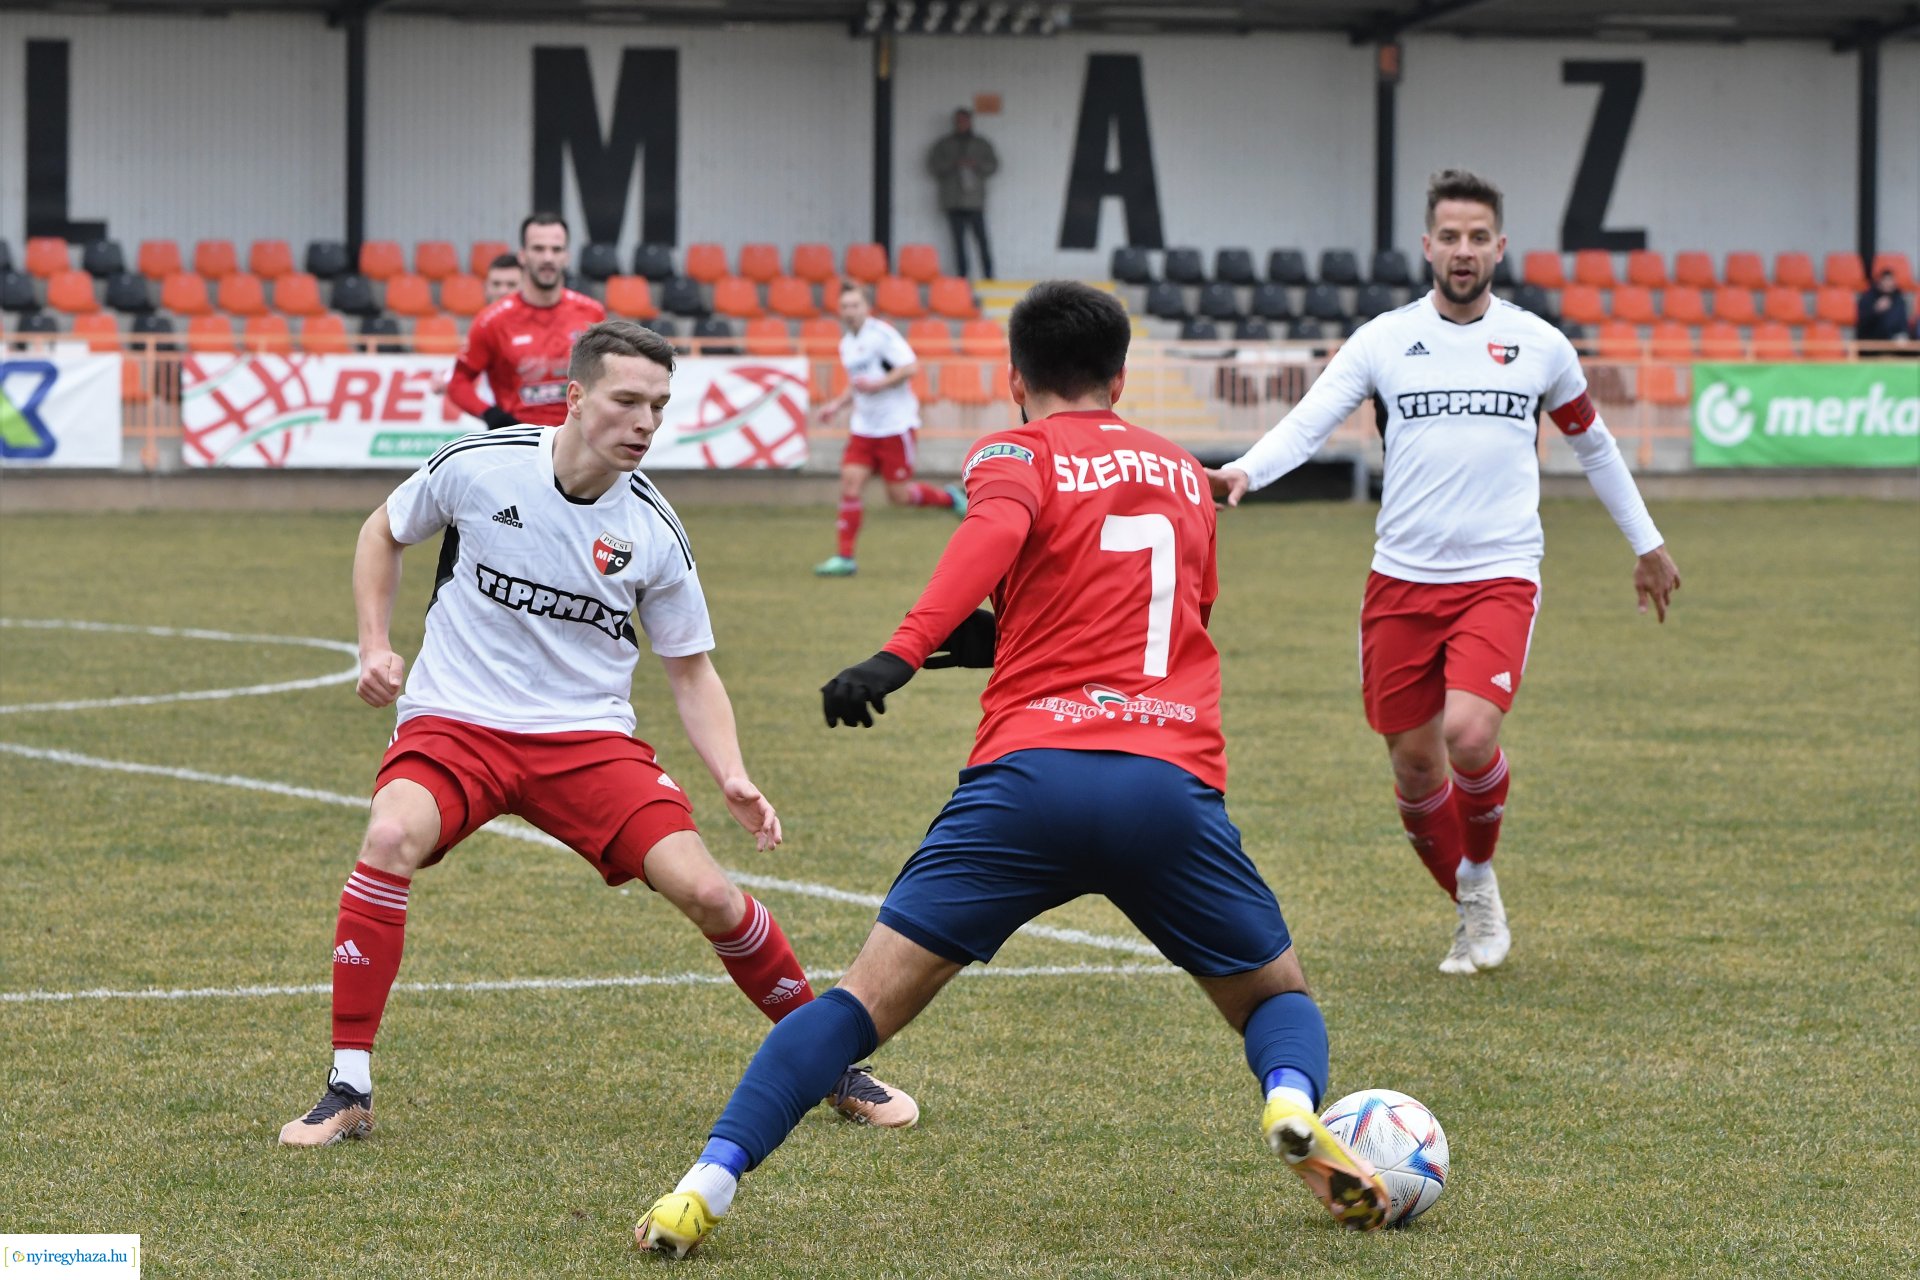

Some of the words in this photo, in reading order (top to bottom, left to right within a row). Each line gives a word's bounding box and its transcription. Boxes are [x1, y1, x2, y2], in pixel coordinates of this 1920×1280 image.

[492, 514, 523, 529] adidas
[595, 548, 625, 567] MFC
[1100, 513, 1176, 678] 7
[762, 978, 808, 1006] adidas
